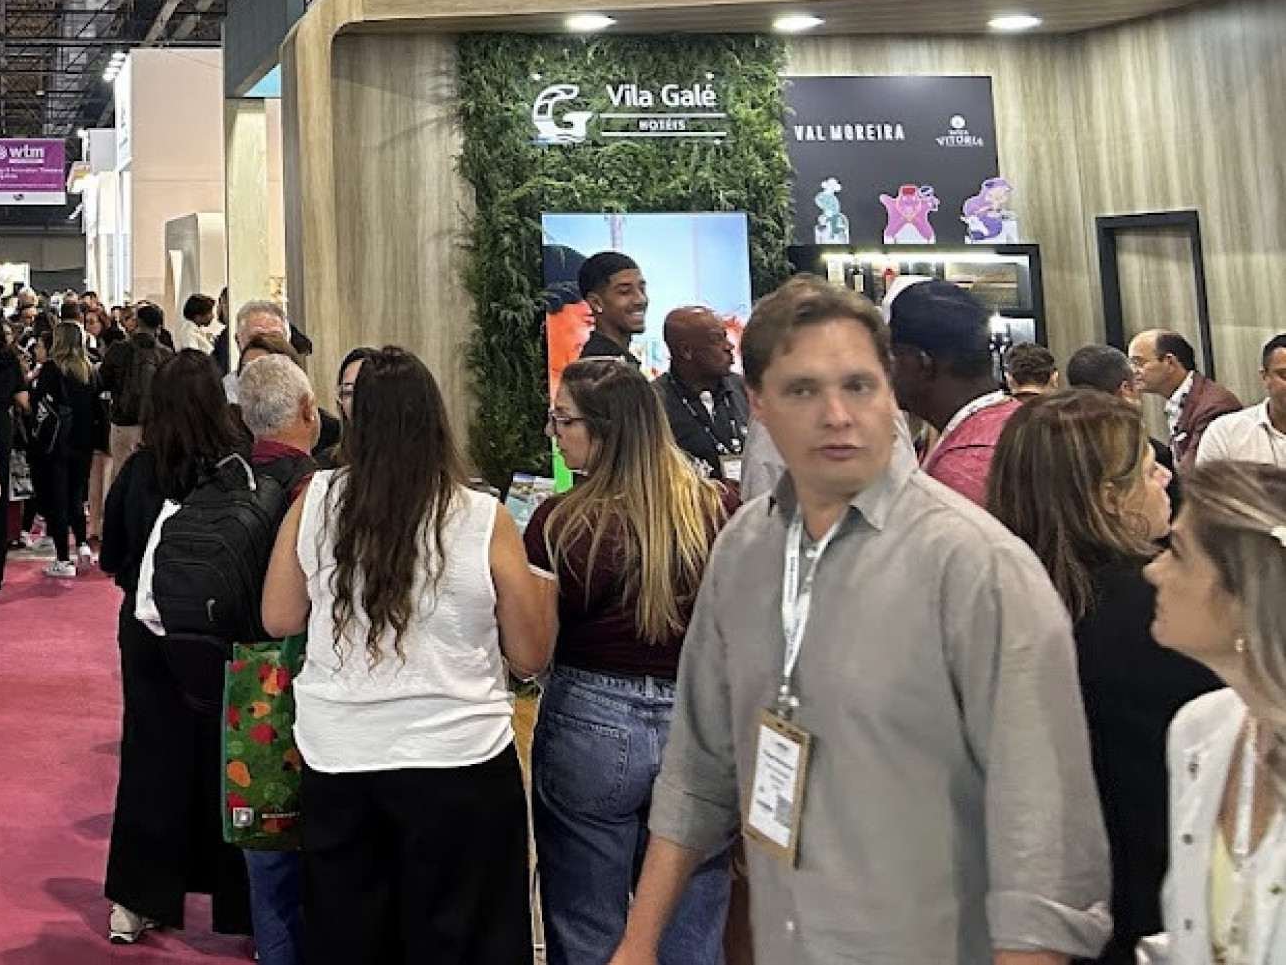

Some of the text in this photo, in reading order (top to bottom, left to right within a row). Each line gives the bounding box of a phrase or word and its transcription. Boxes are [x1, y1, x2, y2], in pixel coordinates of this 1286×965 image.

[605, 84, 717, 107] Vila Galé
[794, 123, 906, 141] VAL MOREIRA
[8, 144, 45, 158] wtm
